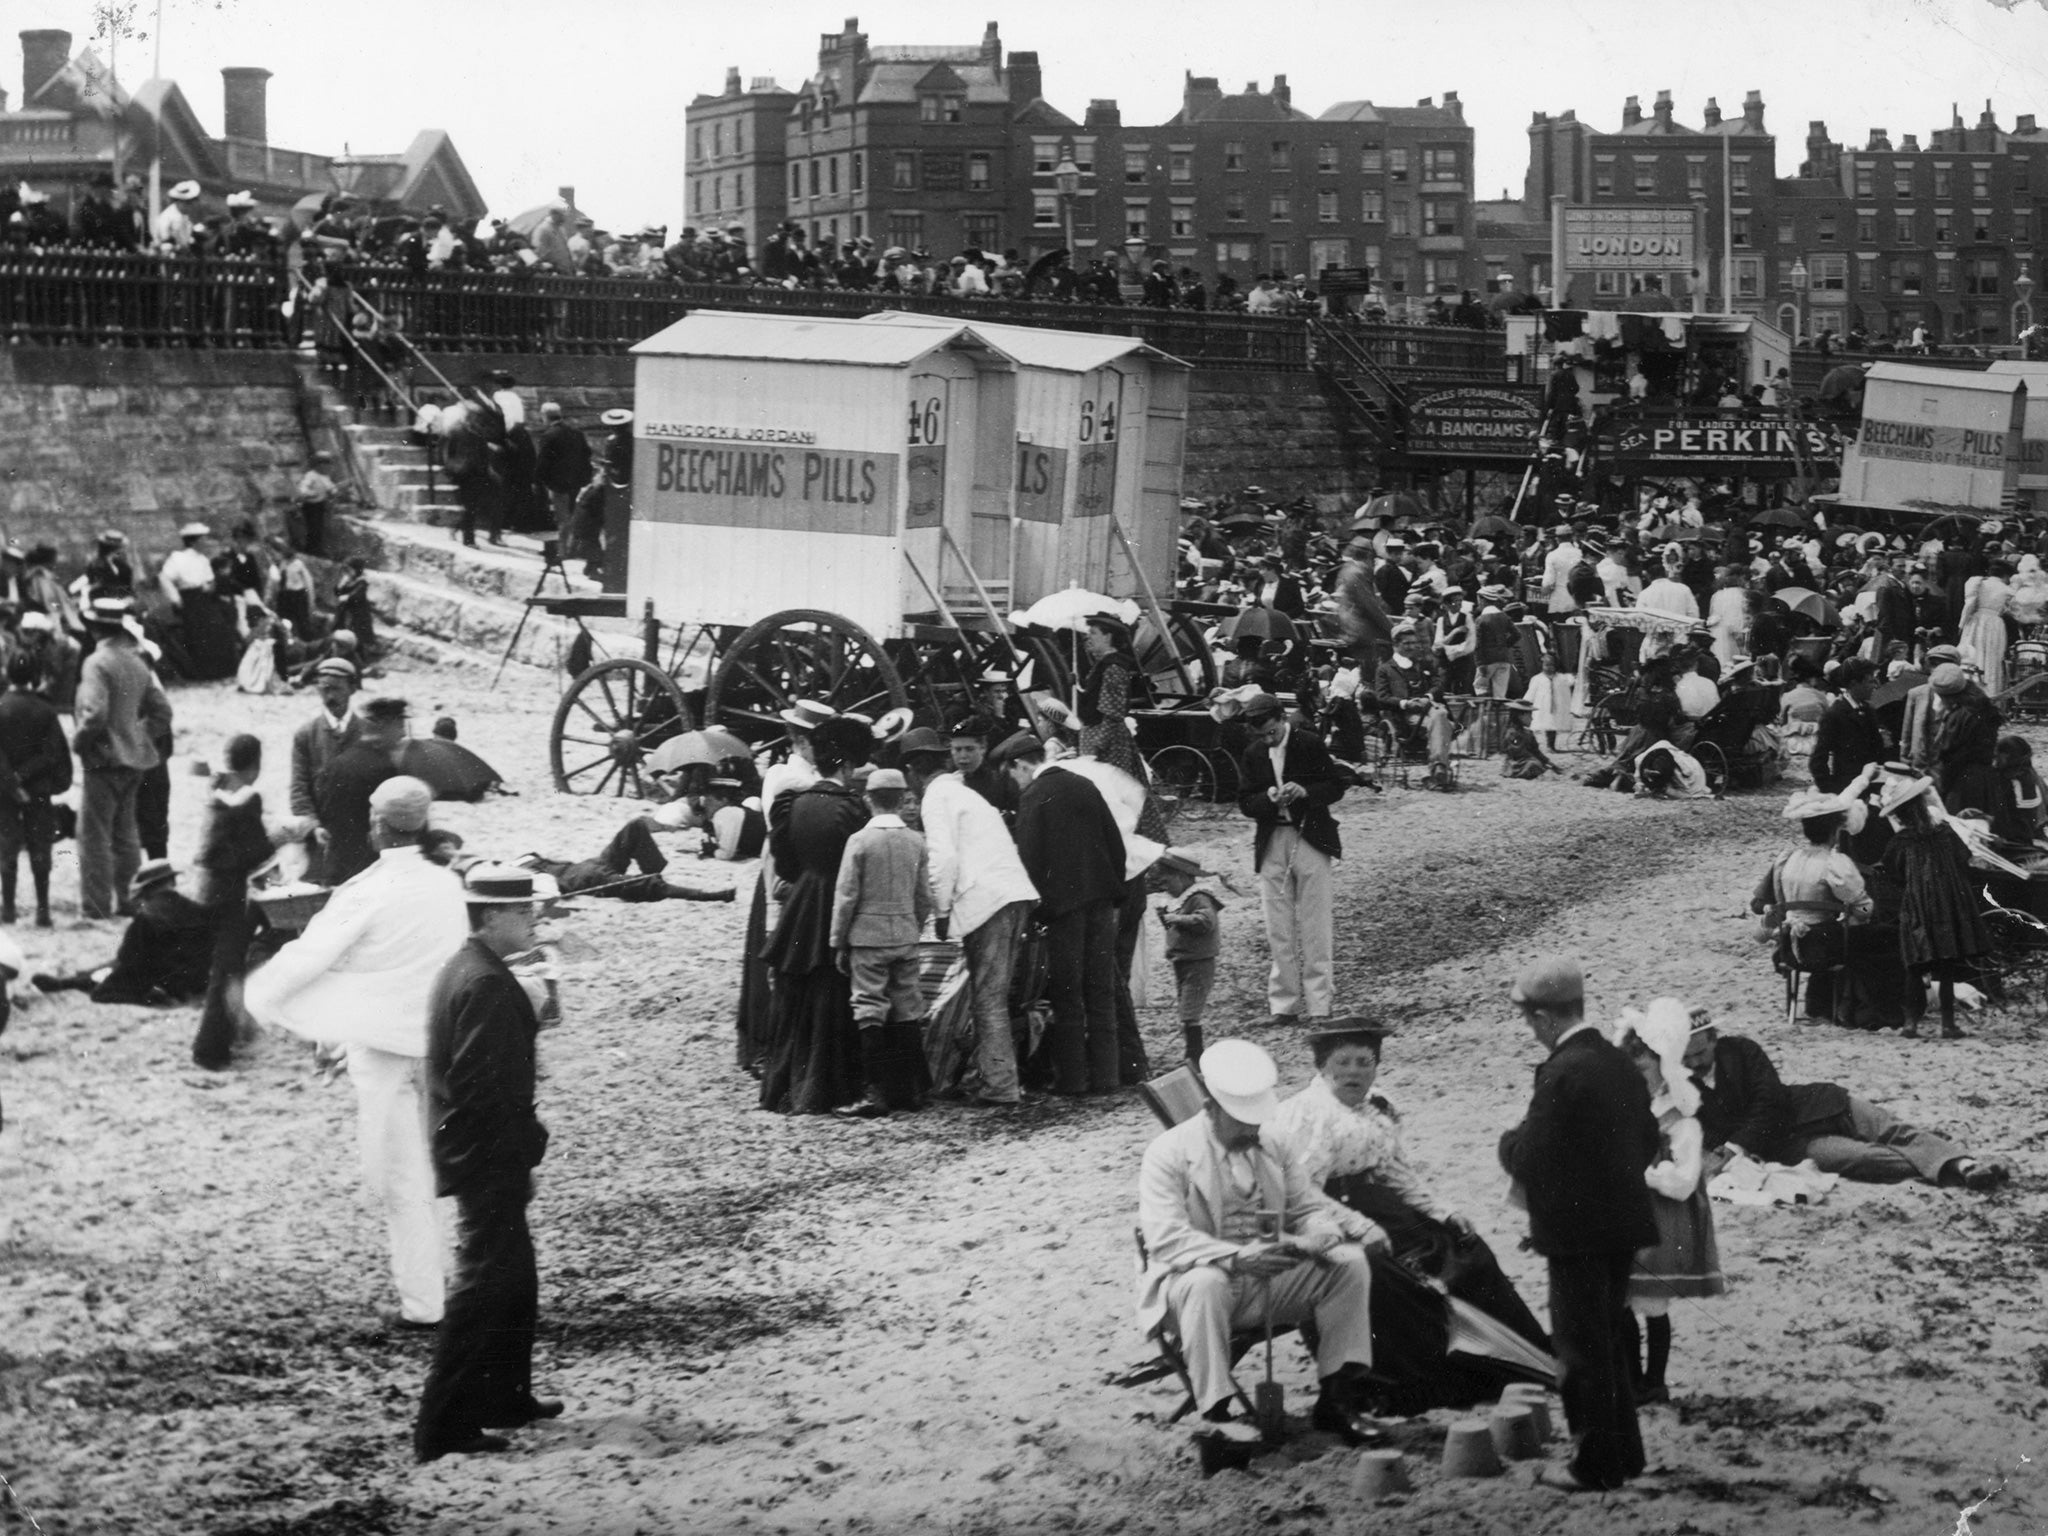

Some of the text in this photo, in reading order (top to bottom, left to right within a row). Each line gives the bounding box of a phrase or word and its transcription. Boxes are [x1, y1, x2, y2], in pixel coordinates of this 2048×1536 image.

[1578, 237, 1681, 256] LONDON
[1409, 387, 1541, 419] BICYCLES PERAMBULATORS
[1424, 407, 1460, 417] WICKER
[1463, 408, 1489, 419] BATH
[645, 422, 729, 440] HANCOCK
[745, 428, 815, 444] JORDAN
[1079, 399, 1115, 443] 64
[1667, 420, 1690, 429] FOR
[1698, 420, 1736, 430] LADIES
[1750, 420, 1818, 431] GENTLEN
[1963, 429, 2004, 456] PILLS
[1860, 443, 2004, 468] THE WONDER OF THE AGE
[803, 451, 876, 505] PILLS
